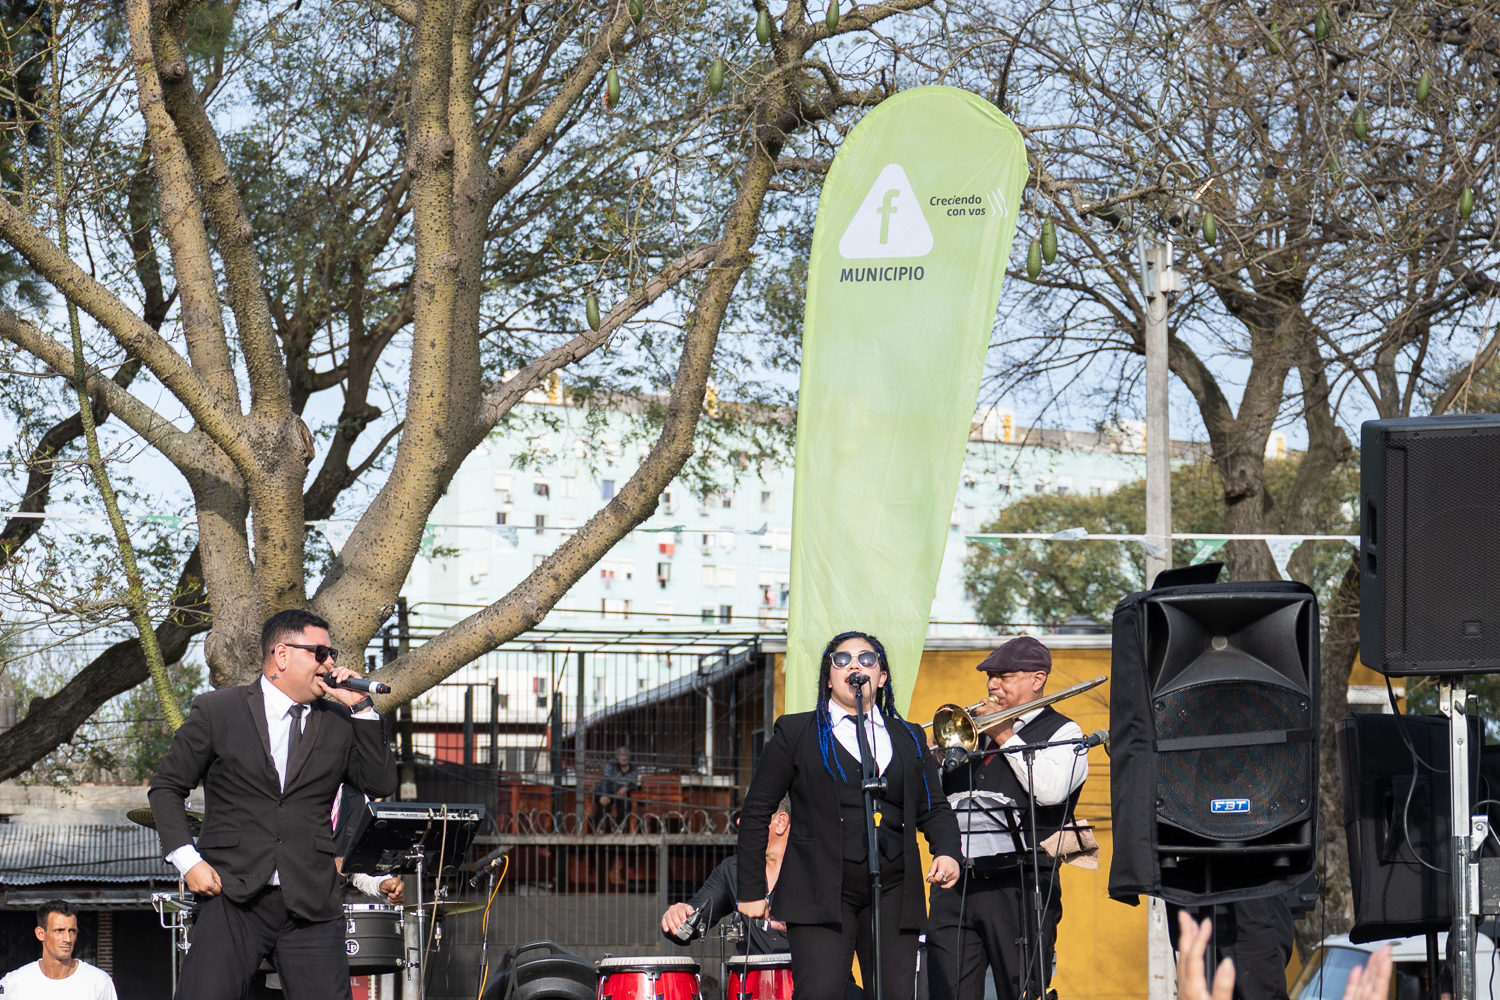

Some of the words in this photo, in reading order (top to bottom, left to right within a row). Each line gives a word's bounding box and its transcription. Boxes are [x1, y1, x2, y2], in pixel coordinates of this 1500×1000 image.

[929, 195, 982, 206] Creciendo
[947, 207, 966, 216] con
[968, 207, 986, 216] vos
[840, 266, 925, 283] MUNICIPIO
[1214, 801, 1247, 811] FBT
